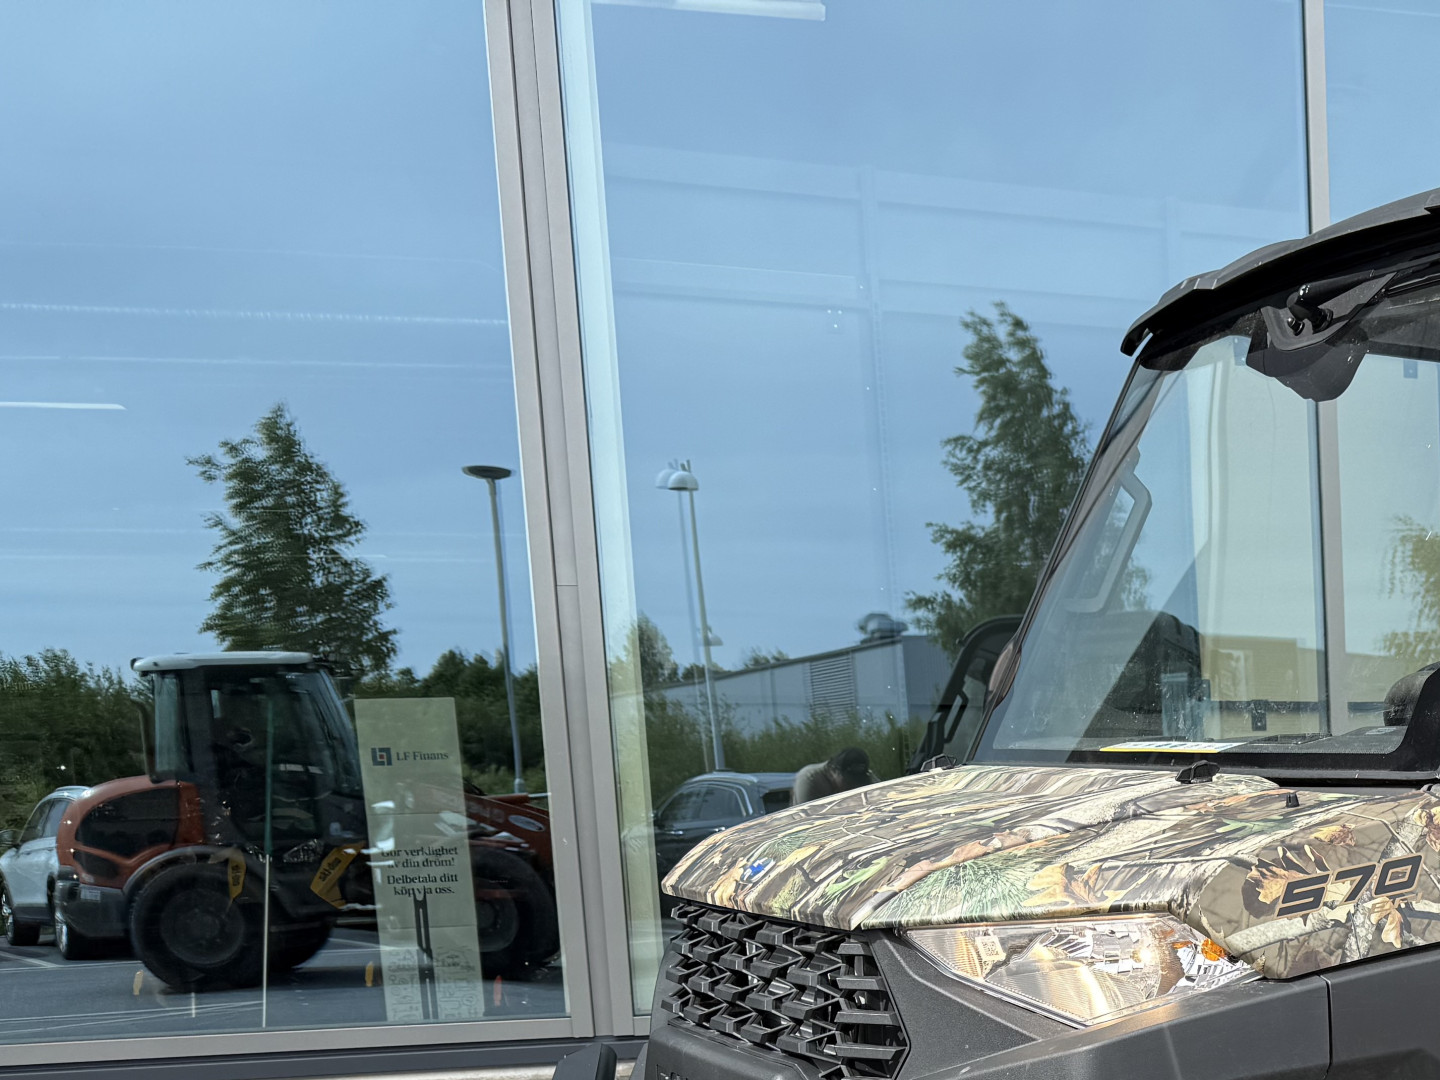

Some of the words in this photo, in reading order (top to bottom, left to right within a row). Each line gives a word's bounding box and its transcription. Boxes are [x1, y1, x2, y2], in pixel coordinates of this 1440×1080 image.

[396, 751, 410, 761] LF
[412, 751, 449, 761] Finans
[404, 845, 459, 858] verklighet
[402, 858, 420, 869] din
[422, 857, 455, 868] dröm!
[387, 873, 438, 885] Delbetala
[439, 872, 459, 883] ditt
[1274, 853, 1425, 919] 570
